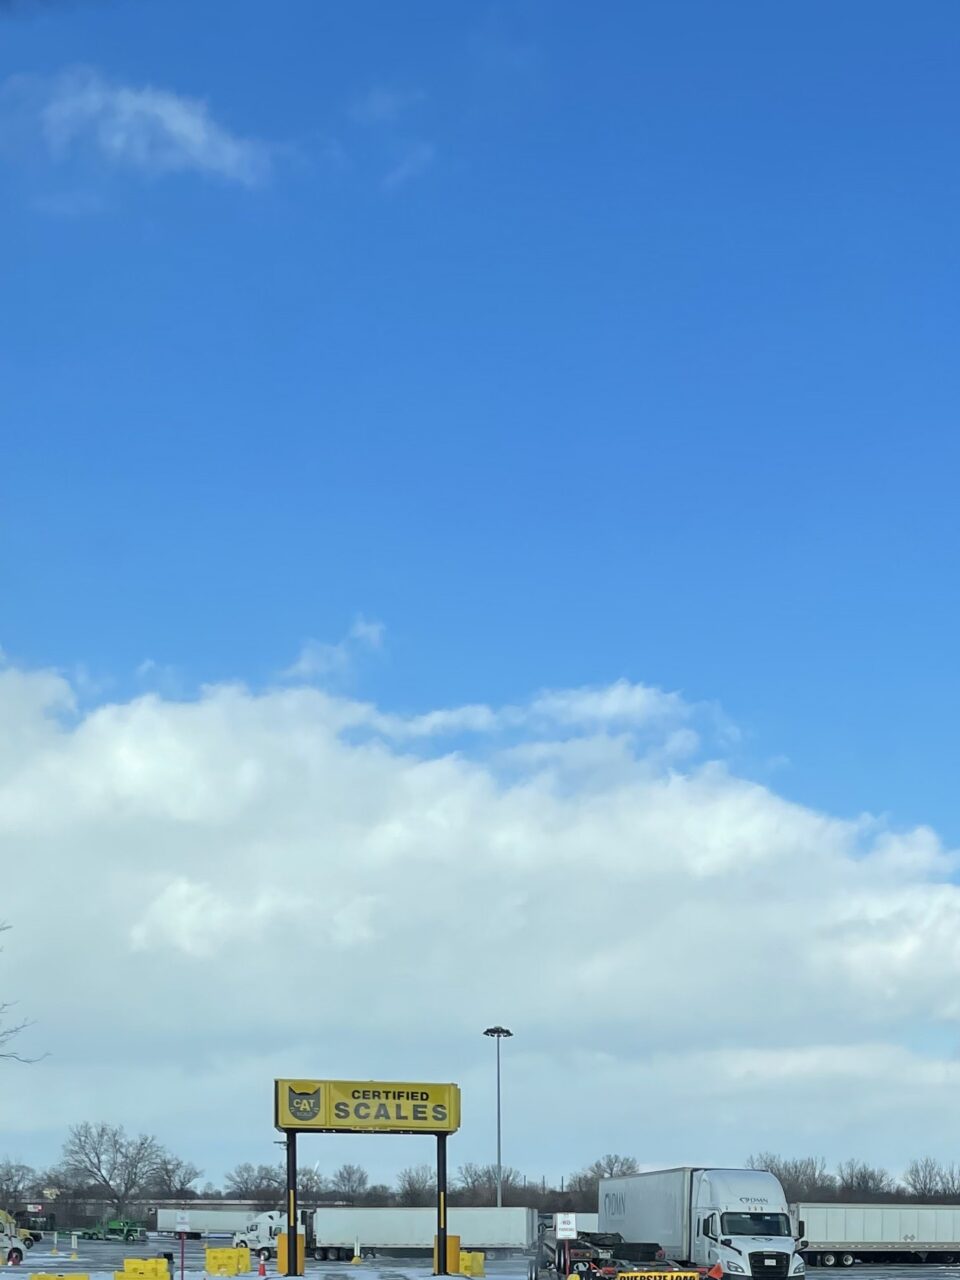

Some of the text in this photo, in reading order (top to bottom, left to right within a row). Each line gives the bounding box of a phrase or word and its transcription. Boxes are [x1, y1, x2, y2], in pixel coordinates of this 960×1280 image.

[352, 1089, 429, 1101] CERTIFIED
[293, 1098, 315, 1112] CAT
[334, 1102, 448, 1122] SCALES
